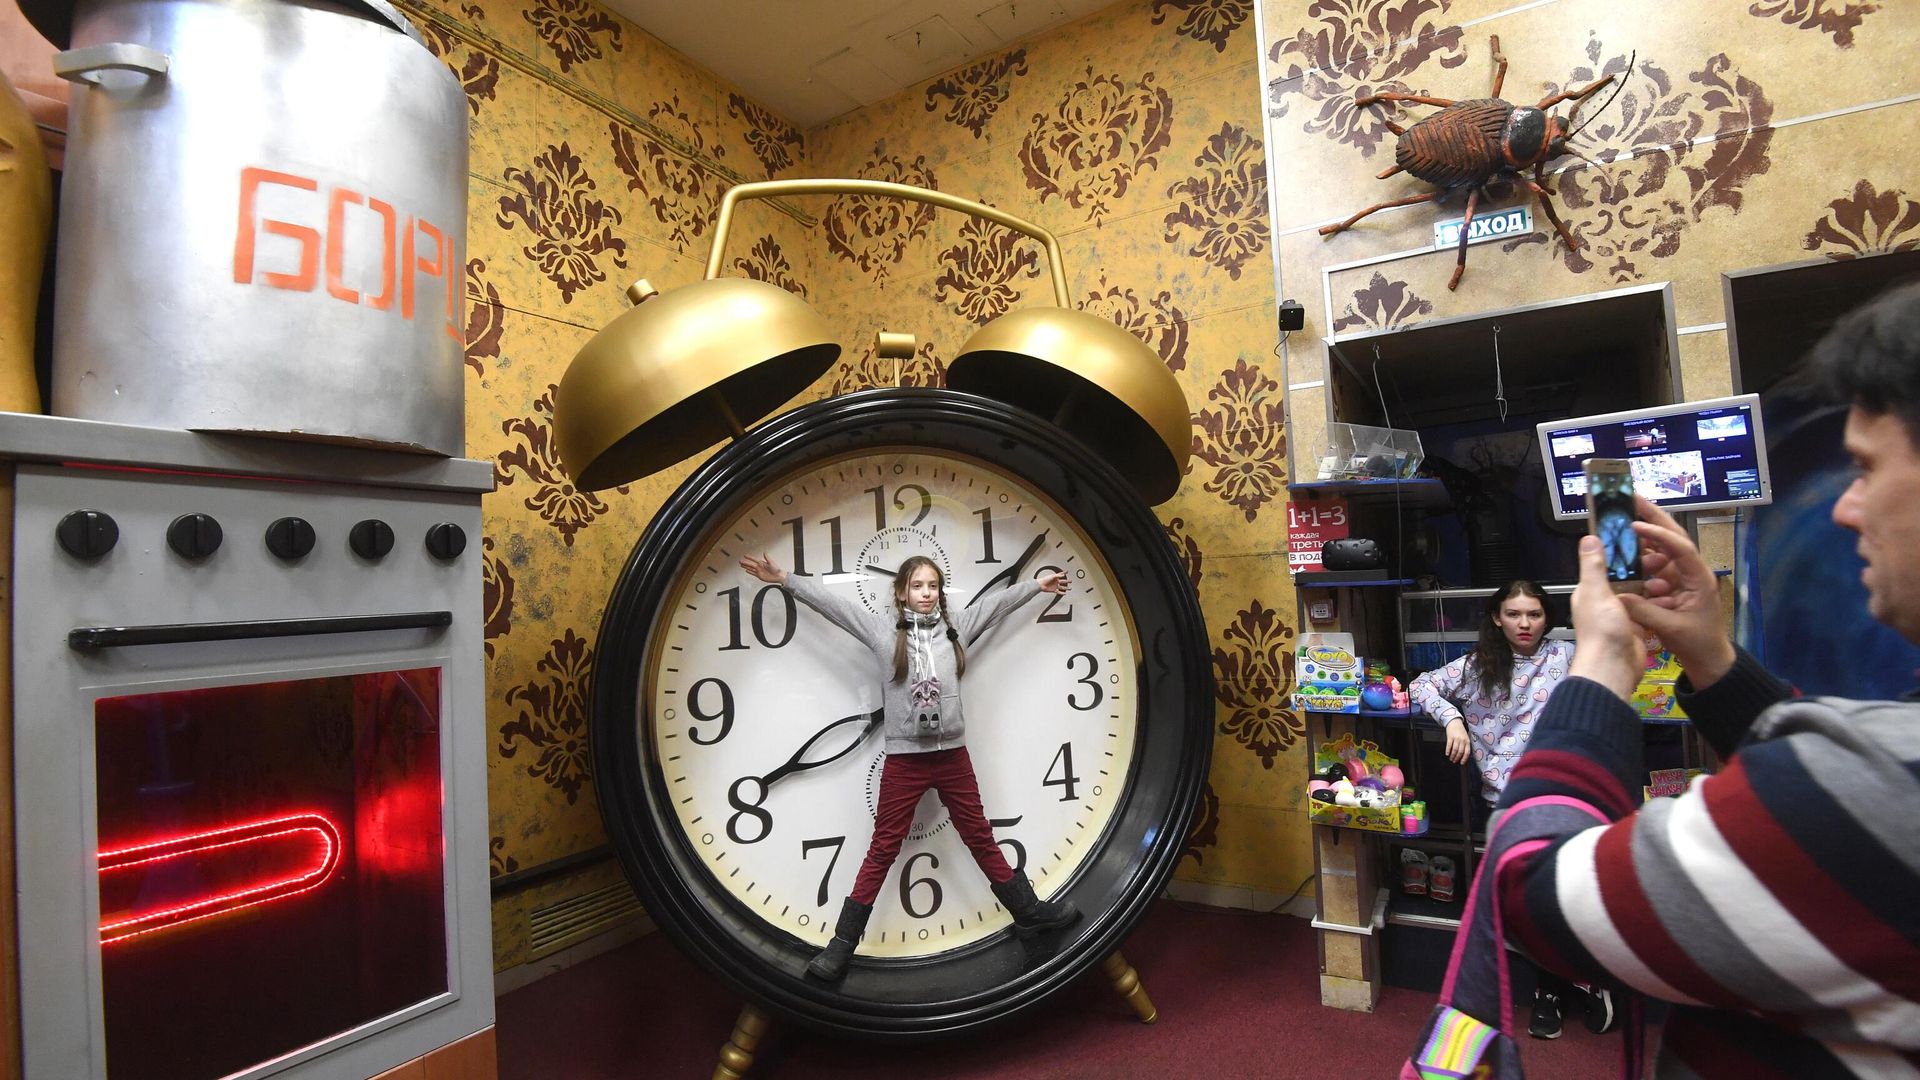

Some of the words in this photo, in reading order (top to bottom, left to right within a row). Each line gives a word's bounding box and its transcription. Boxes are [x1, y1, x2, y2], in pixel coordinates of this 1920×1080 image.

[864, 483, 937, 537] 12
[972, 506, 1002, 565] 1
[1288, 505, 1346, 528] 1+1=3
[782, 514, 856, 577] 11
[1291, 540, 1326, 551] треть
[717, 584, 798, 651] 10
[1033, 565, 1073, 624] 2
[686, 677, 736, 746] 9
[1066, 652, 1104, 711] 3
[1041, 741, 1081, 803] 4
[725, 775, 774, 844] 8
[801, 834, 847, 908] 7
[900, 851, 944, 919] 6
